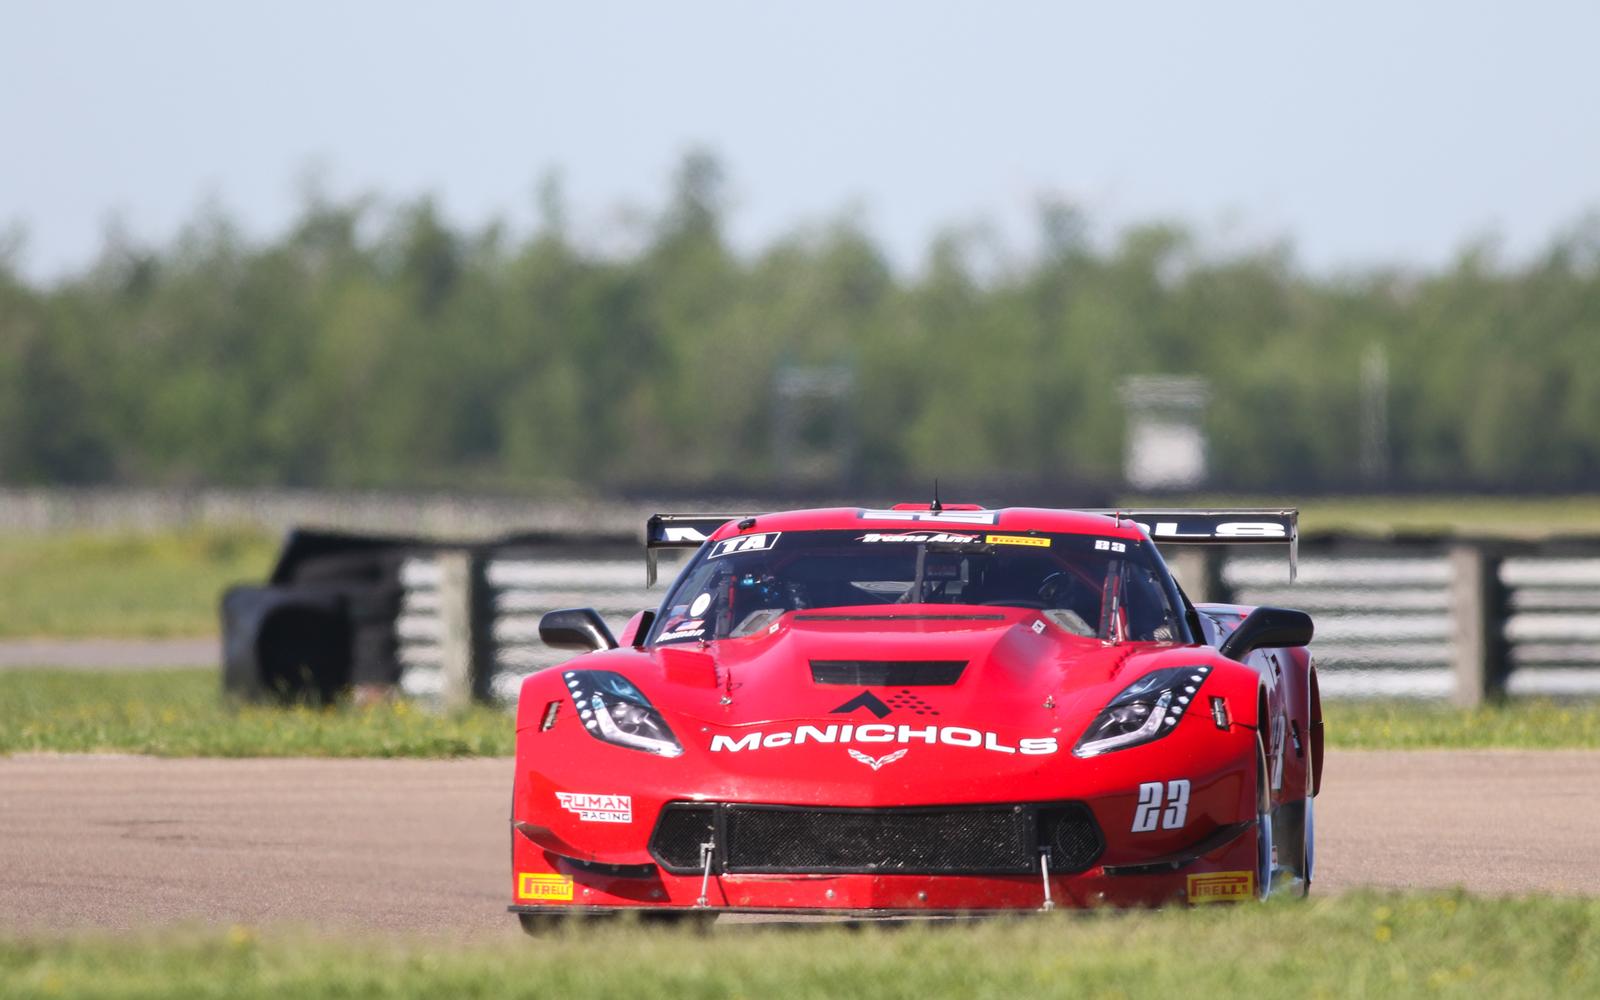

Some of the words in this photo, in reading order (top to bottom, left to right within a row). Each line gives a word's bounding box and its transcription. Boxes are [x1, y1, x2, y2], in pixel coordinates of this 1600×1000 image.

[721, 534, 767, 554] TA
[710, 724, 1059, 754] McNICHOLS
[558, 795, 630, 810] RUMAN
[1131, 779, 1191, 832] 23
[582, 811, 630, 821] RACING
[524, 877, 570, 895] PIRELLI
[1191, 876, 1249, 897] PIRELLI
